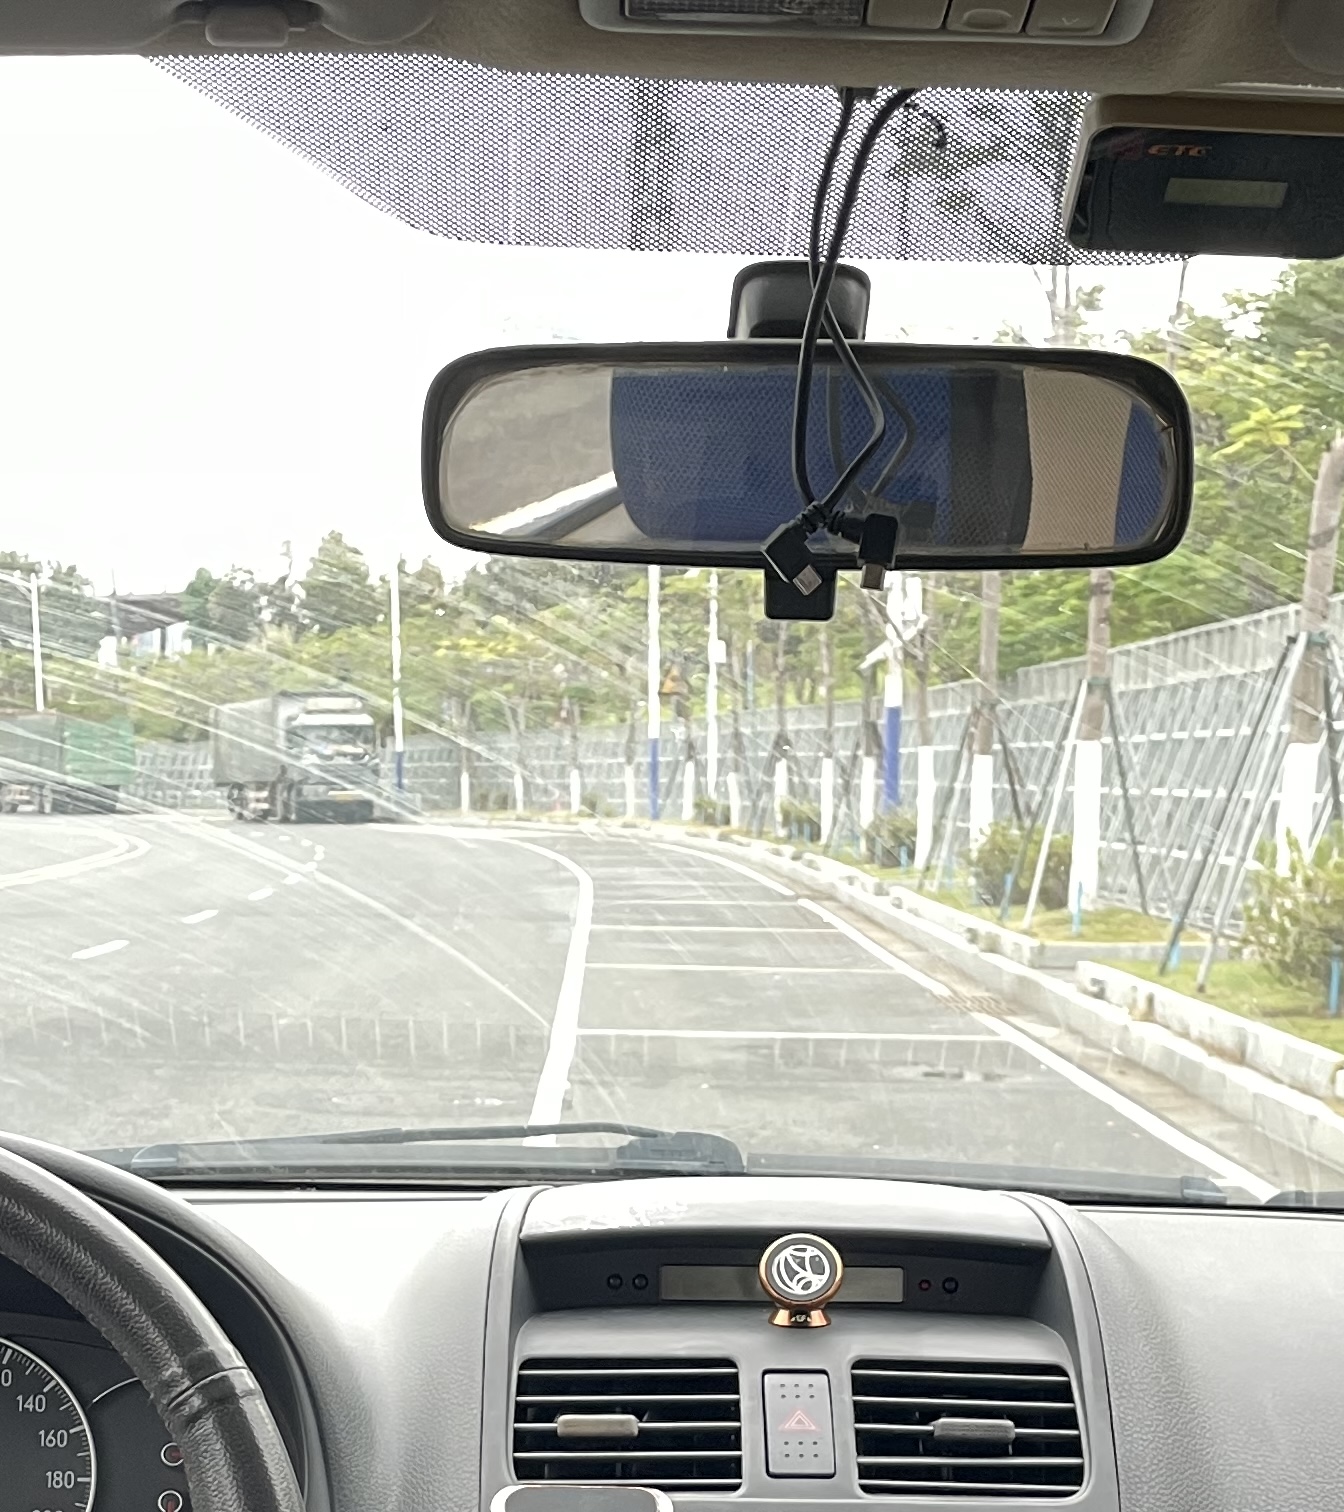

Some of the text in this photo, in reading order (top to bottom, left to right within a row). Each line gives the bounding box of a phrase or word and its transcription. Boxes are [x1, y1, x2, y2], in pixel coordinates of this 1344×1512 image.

[16, 1394, 46, 1413] 140
[38, 1430, 68, 1448] 160
[45, 1471, 75, 1489] 180
